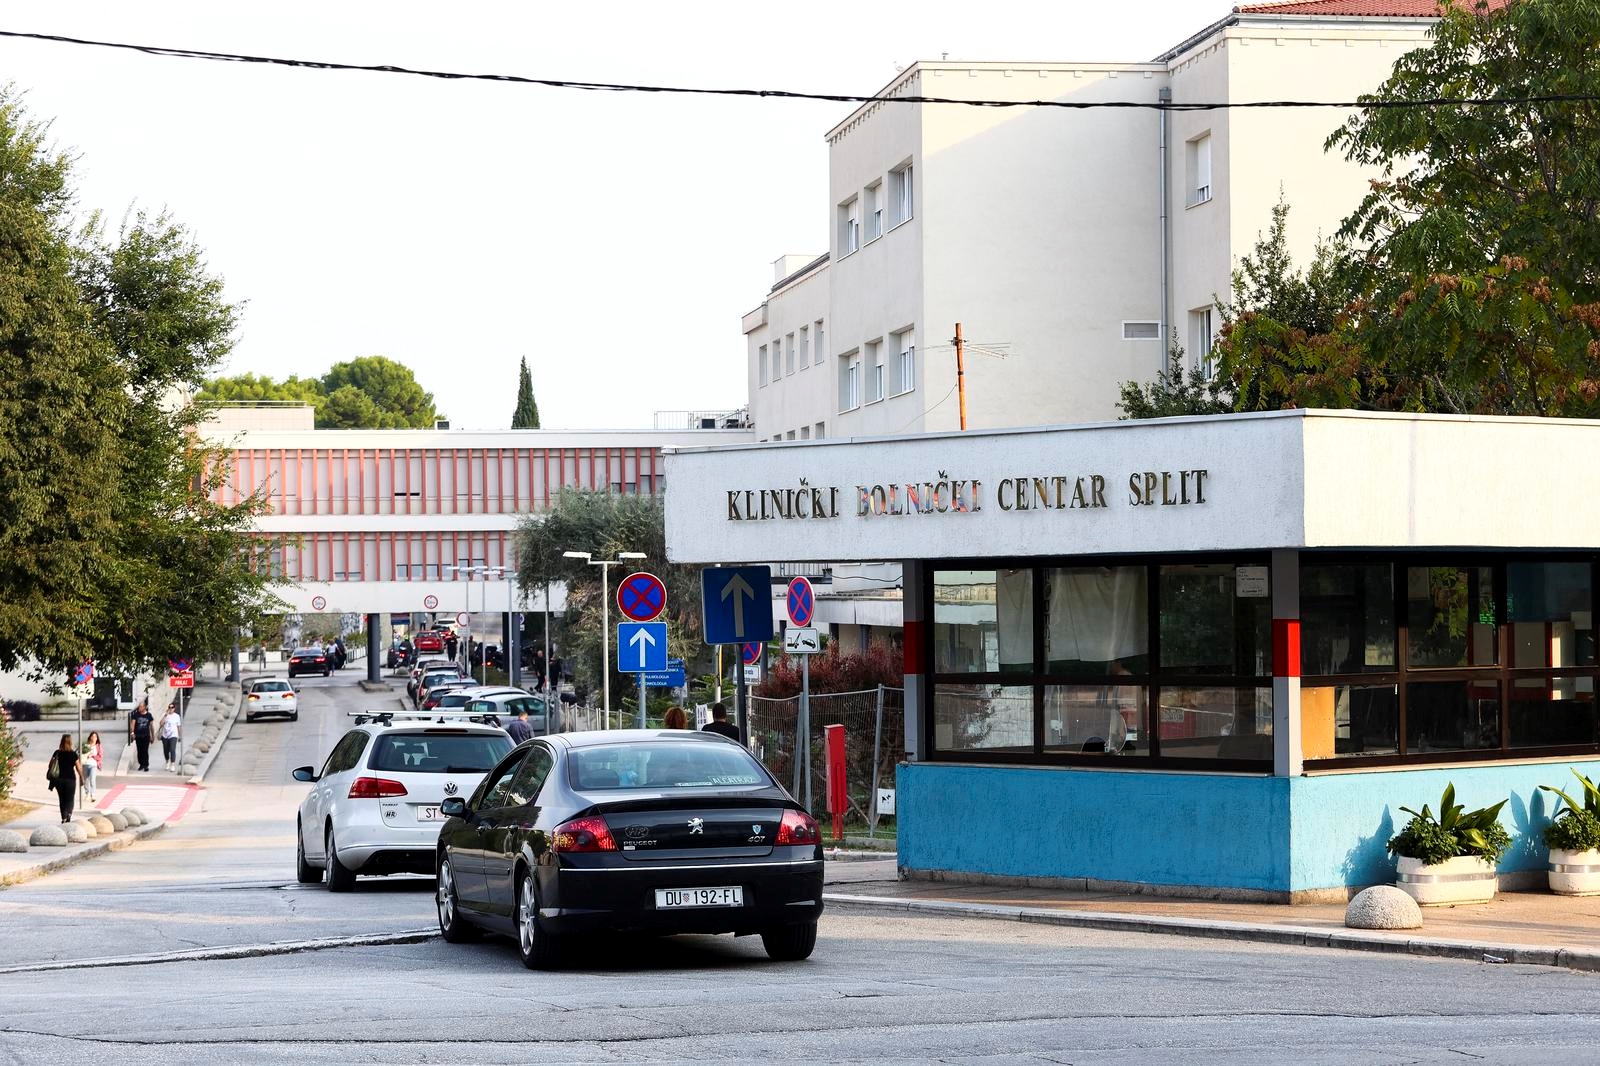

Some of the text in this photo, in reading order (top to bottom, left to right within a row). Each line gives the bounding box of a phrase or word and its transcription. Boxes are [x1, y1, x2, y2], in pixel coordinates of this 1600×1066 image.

[727, 469, 1208, 521] KLINIČKI BOLNIČKI CENTAR SPLIT
[425, 807, 438, 819] ST
[748, 835, 766, 843] 407
[665, 888, 740, 906] DU 192-FL
